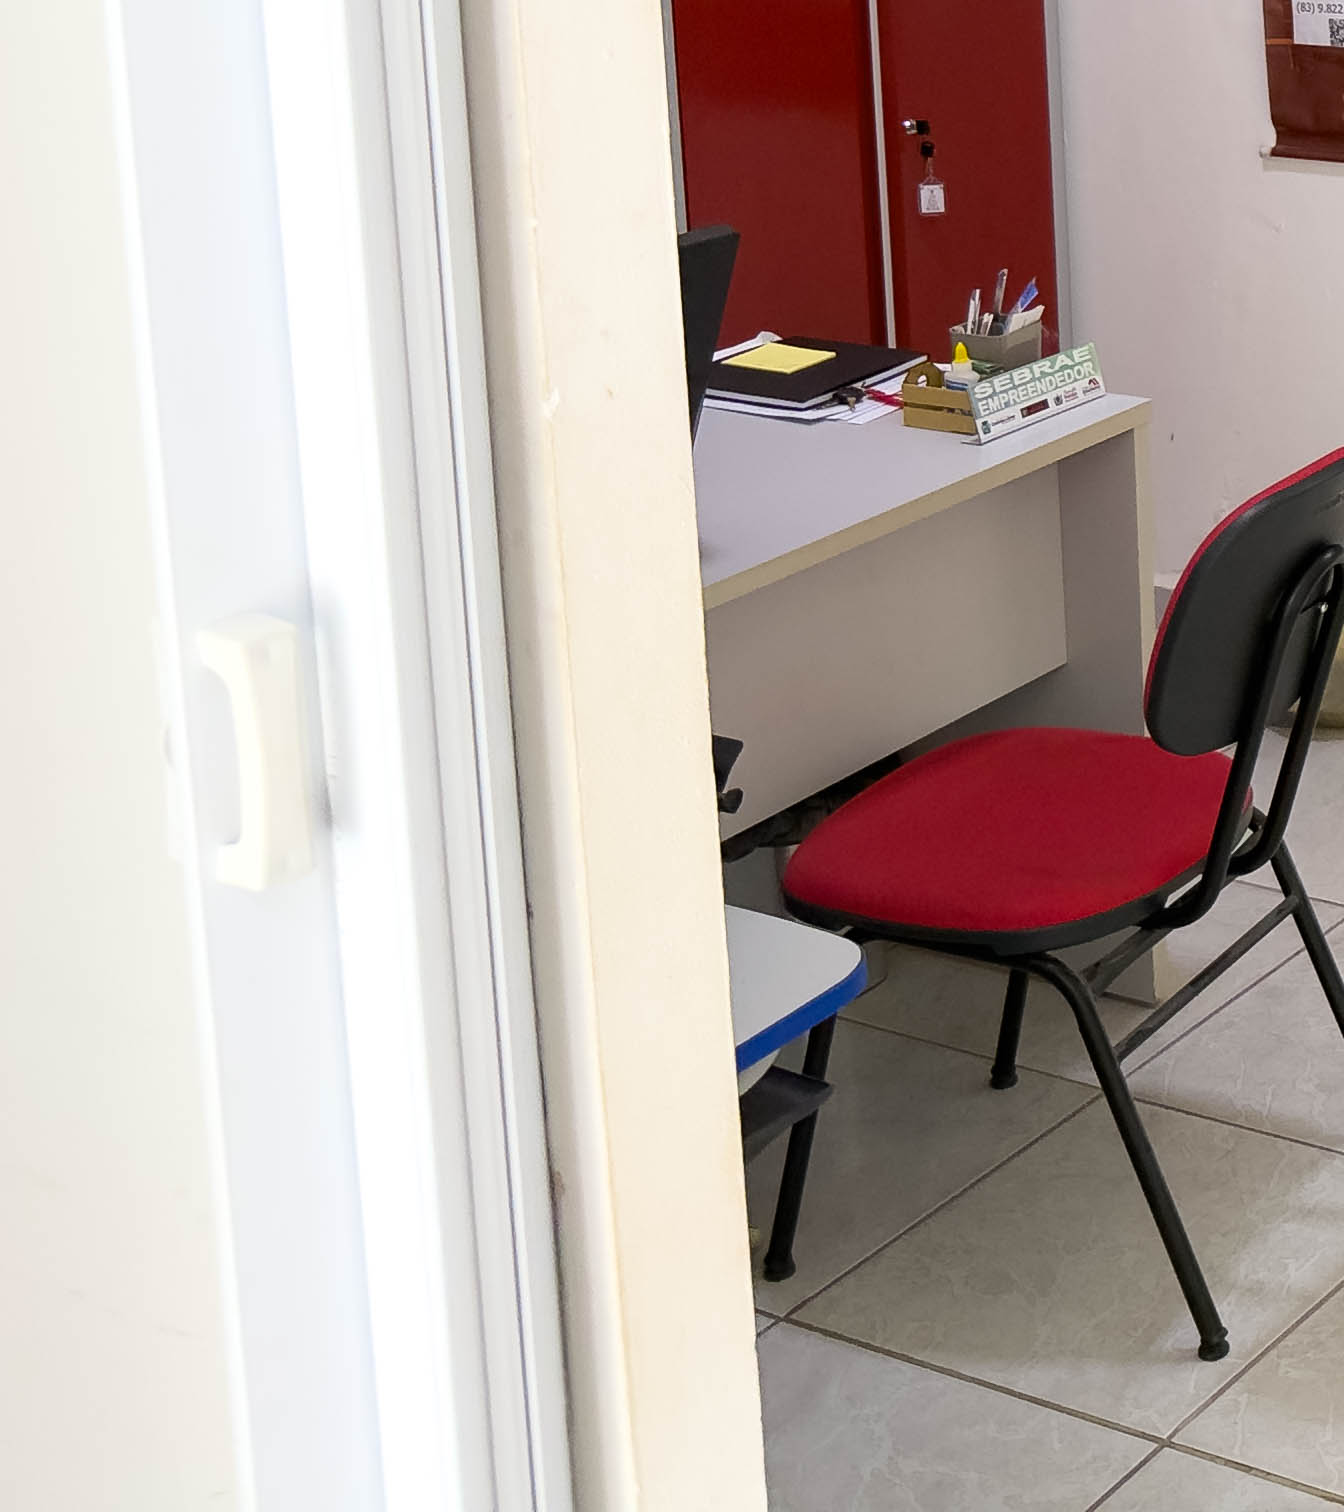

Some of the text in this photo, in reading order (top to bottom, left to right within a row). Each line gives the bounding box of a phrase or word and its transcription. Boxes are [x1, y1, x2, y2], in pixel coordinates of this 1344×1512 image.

[1296, 1, 1315, 15] (83)
[974, 346, 1093, 399] SEBRAE
[978, 361, 1096, 417] EMPREENDEDOR
